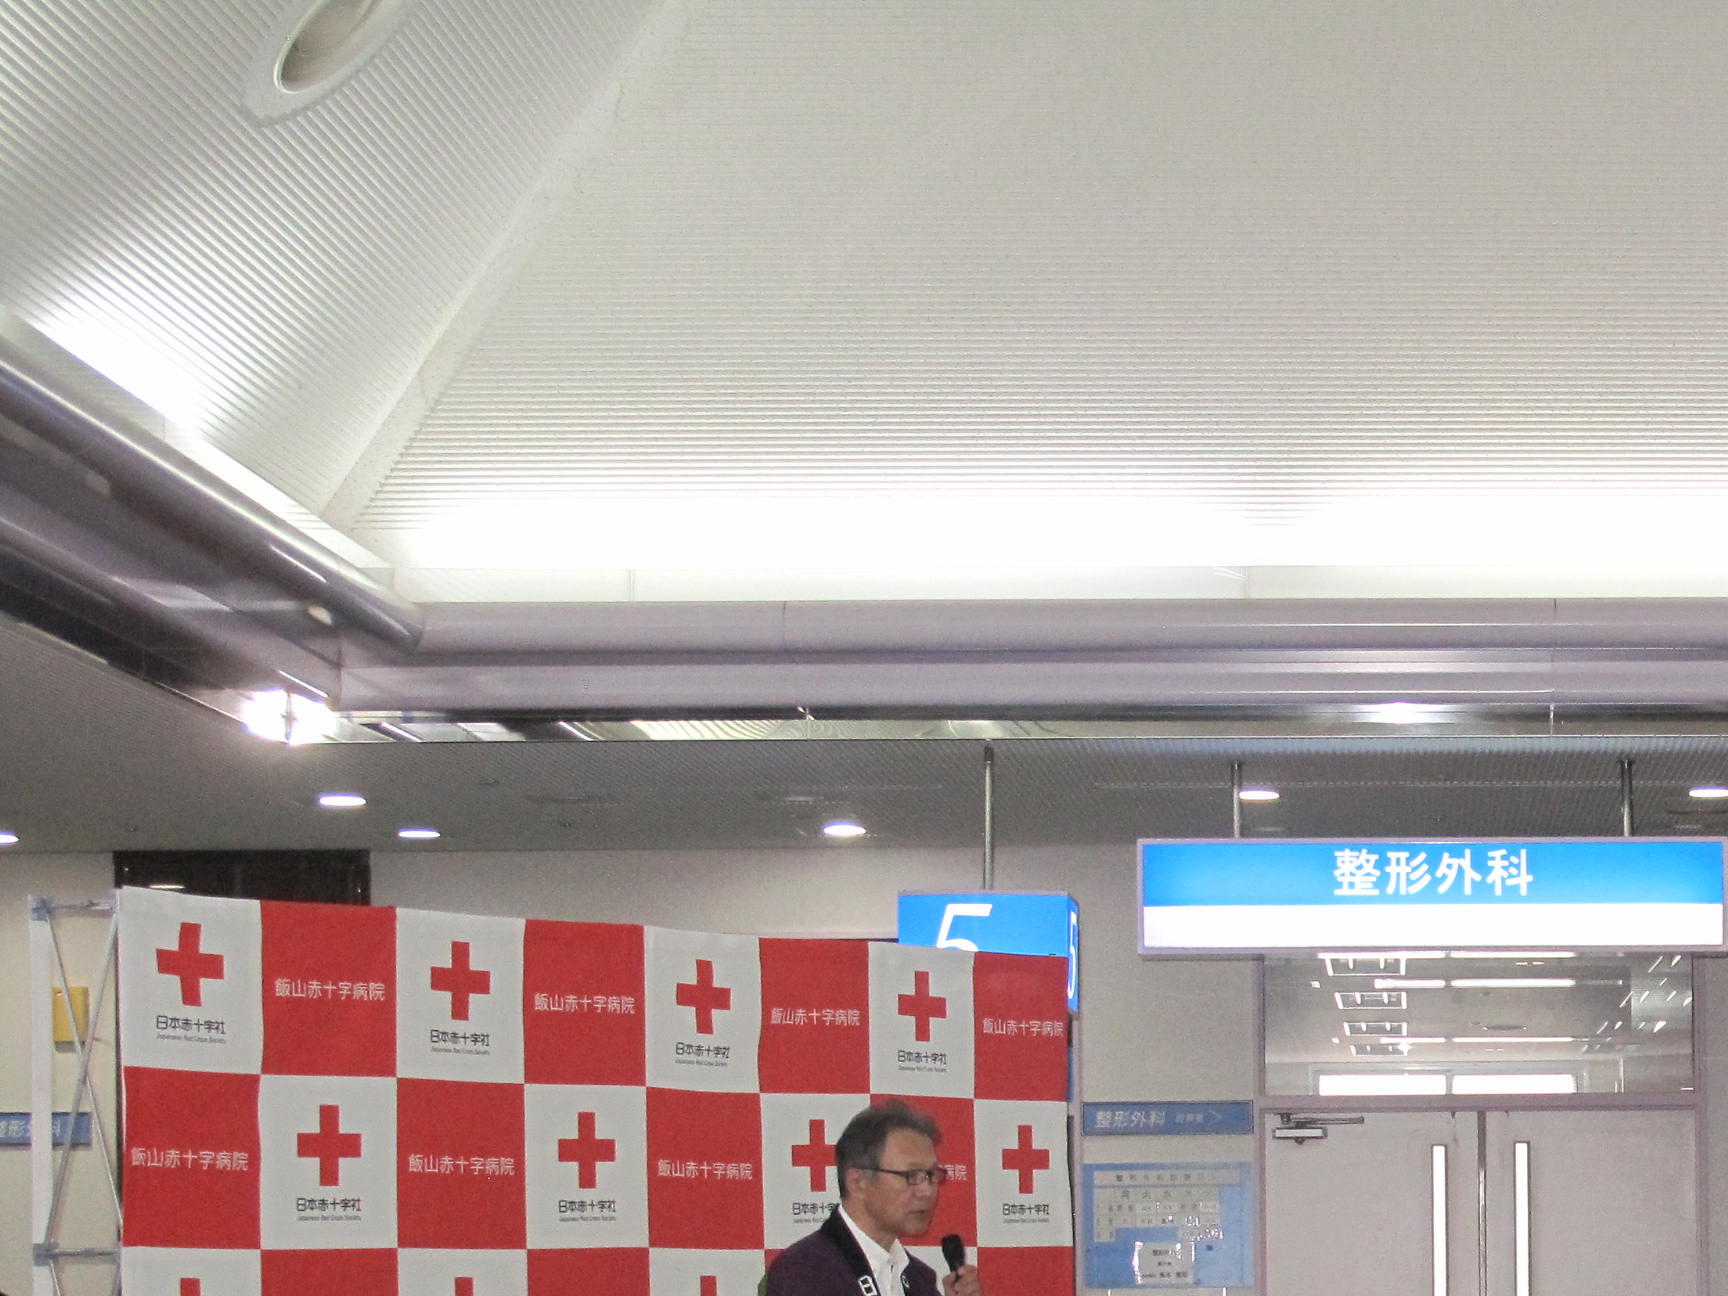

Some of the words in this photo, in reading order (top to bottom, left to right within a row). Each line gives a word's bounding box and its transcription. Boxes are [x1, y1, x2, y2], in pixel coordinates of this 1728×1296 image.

[1333, 849, 1533, 897] 整形外科
[275, 978, 385, 1000] 飯山赤十字病院
[535, 993, 635, 1014] 飯山赤十字病院
[156, 1015, 225, 1034] 日本赤十字社
[771, 1008, 860, 1026] 飯山赤十字病院
[983, 1018, 1063, 1036] 飯山赤十字病院
[431, 1030, 489, 1046] 日本赤十字社
[676, 1042, 730, 1058] 日本赤十字社
[898, 1050, 946, 1065] 日本赤十字社
[1095, 1111, 1165, 1128] 整形外科
[131, 1147, 248, 1171] 飯山赤十字病院
[409, 1154, 514, 1175] 飯山赤十字病院
[658, 1160, 752, 1179] 飯山赤十字病院
[297, 1198, 361, 1211] 日本赤十字社
[559, 1200, 616, 1213] 日本赤十字社
[1003, 1203, 1049, 1215] 日本赤十字社
